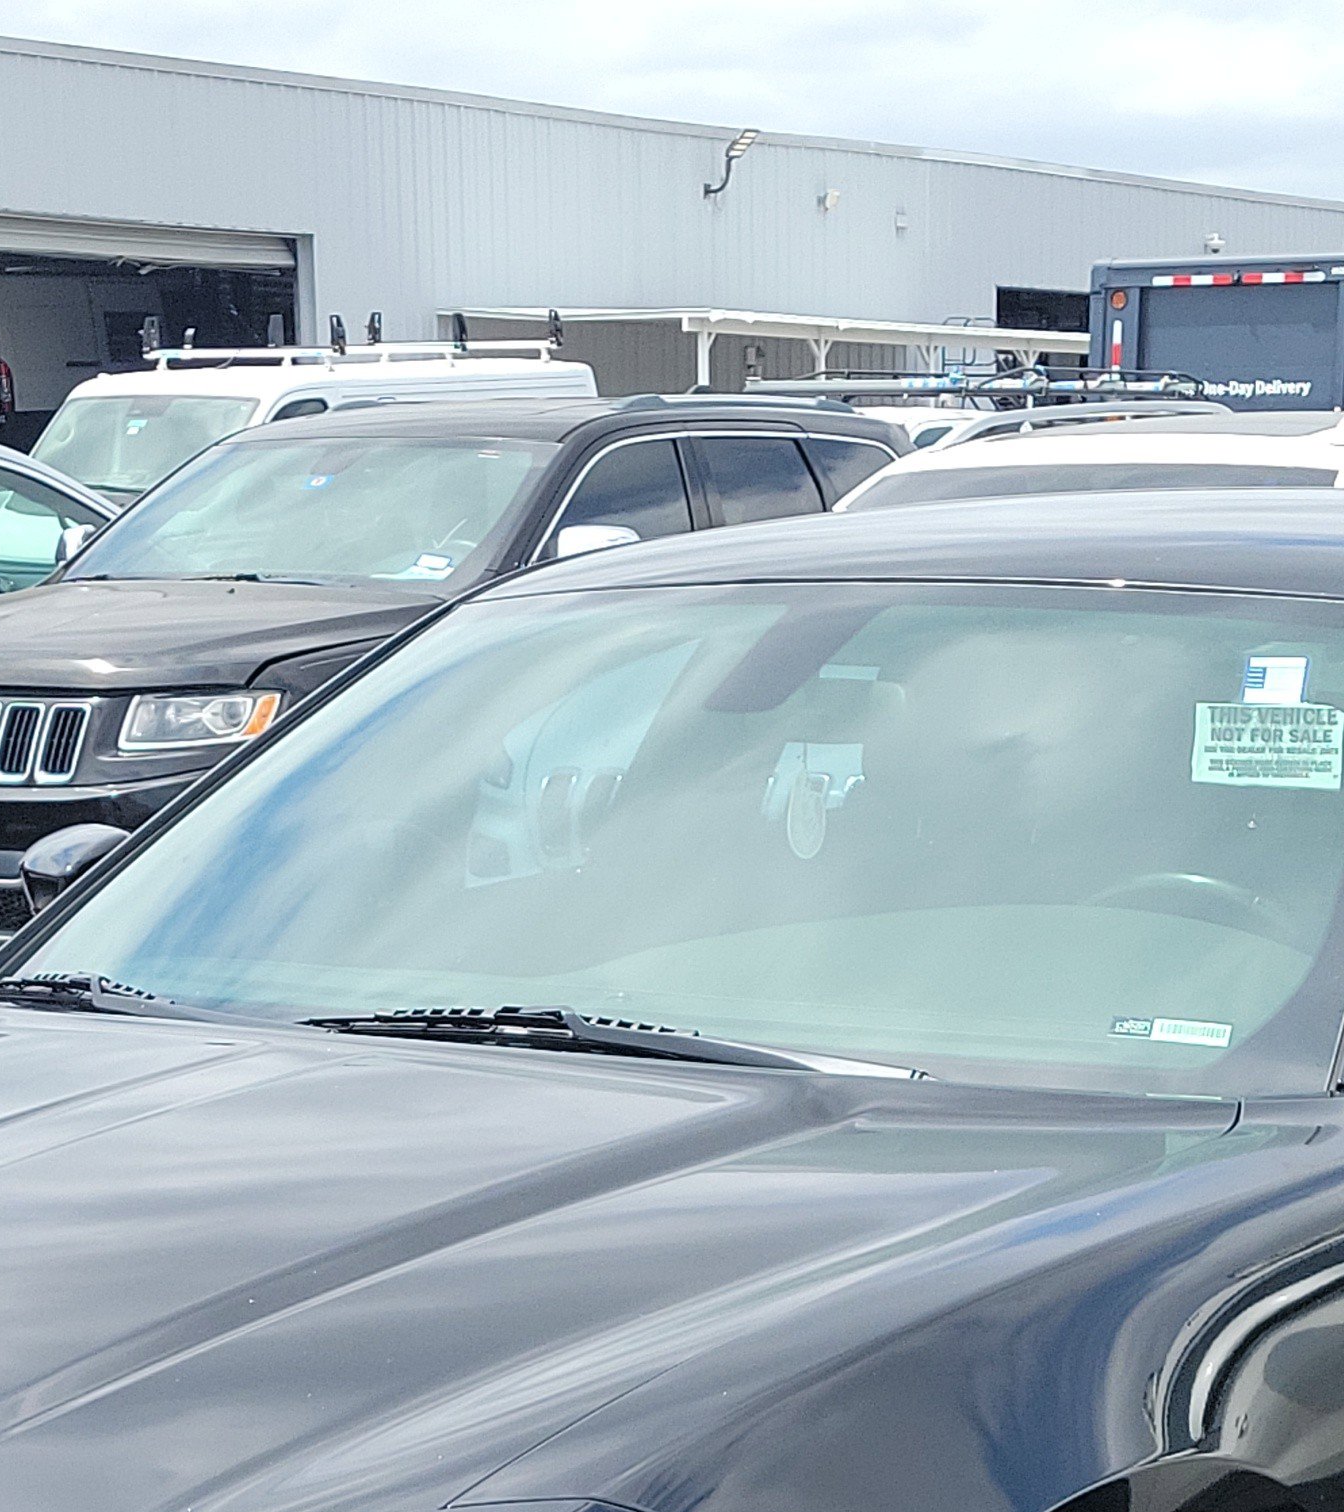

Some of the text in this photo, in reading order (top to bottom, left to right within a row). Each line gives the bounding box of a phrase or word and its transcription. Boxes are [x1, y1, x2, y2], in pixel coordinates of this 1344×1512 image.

[1255, 379, 1312, 397] Delivery
[1208, 706, 1339, 726] THIS VEHICLE
[1211, 728, 1333, 743] NOT FOR SALE
